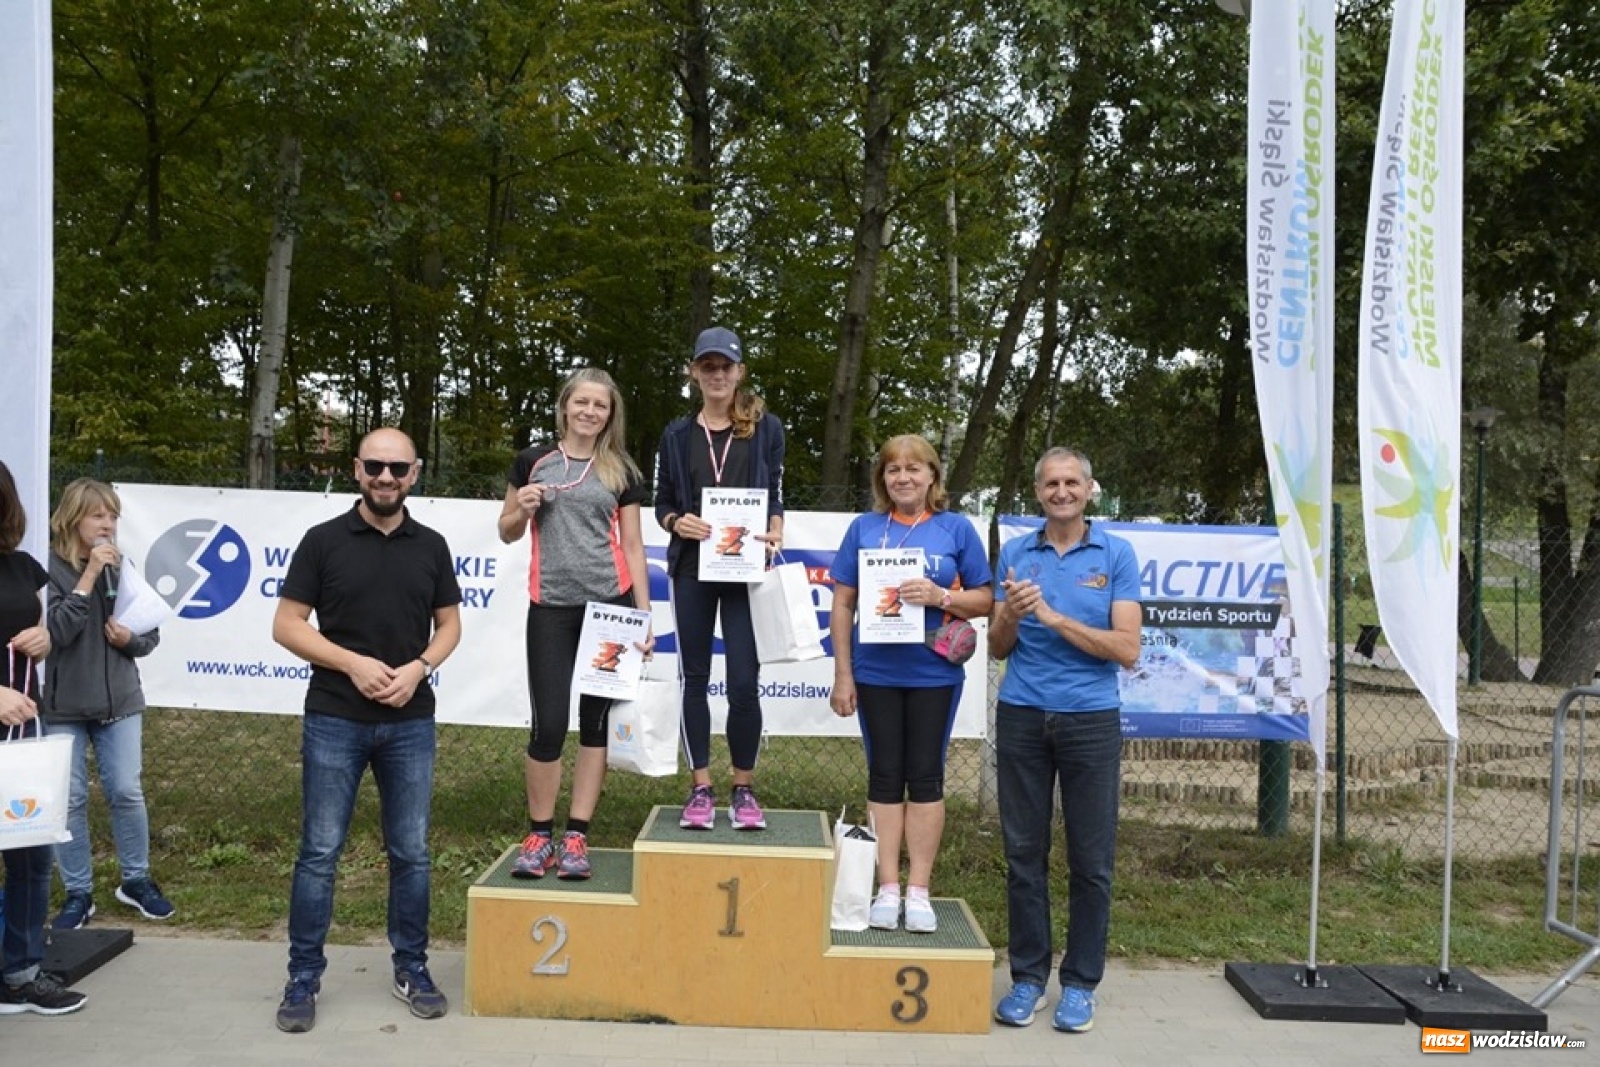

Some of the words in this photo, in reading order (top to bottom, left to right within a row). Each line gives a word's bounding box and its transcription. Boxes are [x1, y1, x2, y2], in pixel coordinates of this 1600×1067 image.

[709, 496, 761, 506] DYPLOM
[866, 557, 918, 567] DYPLOM
[592, 611, 644, 628] DYPLOM
[1146, 605, 1213, 623] Tydzień
[1217, 608, 1272, 625] Sportu
[717, 877, 744, 938] 1
[531, 914, 570, 977] 2
[891, 965, 931, 1024] 3
